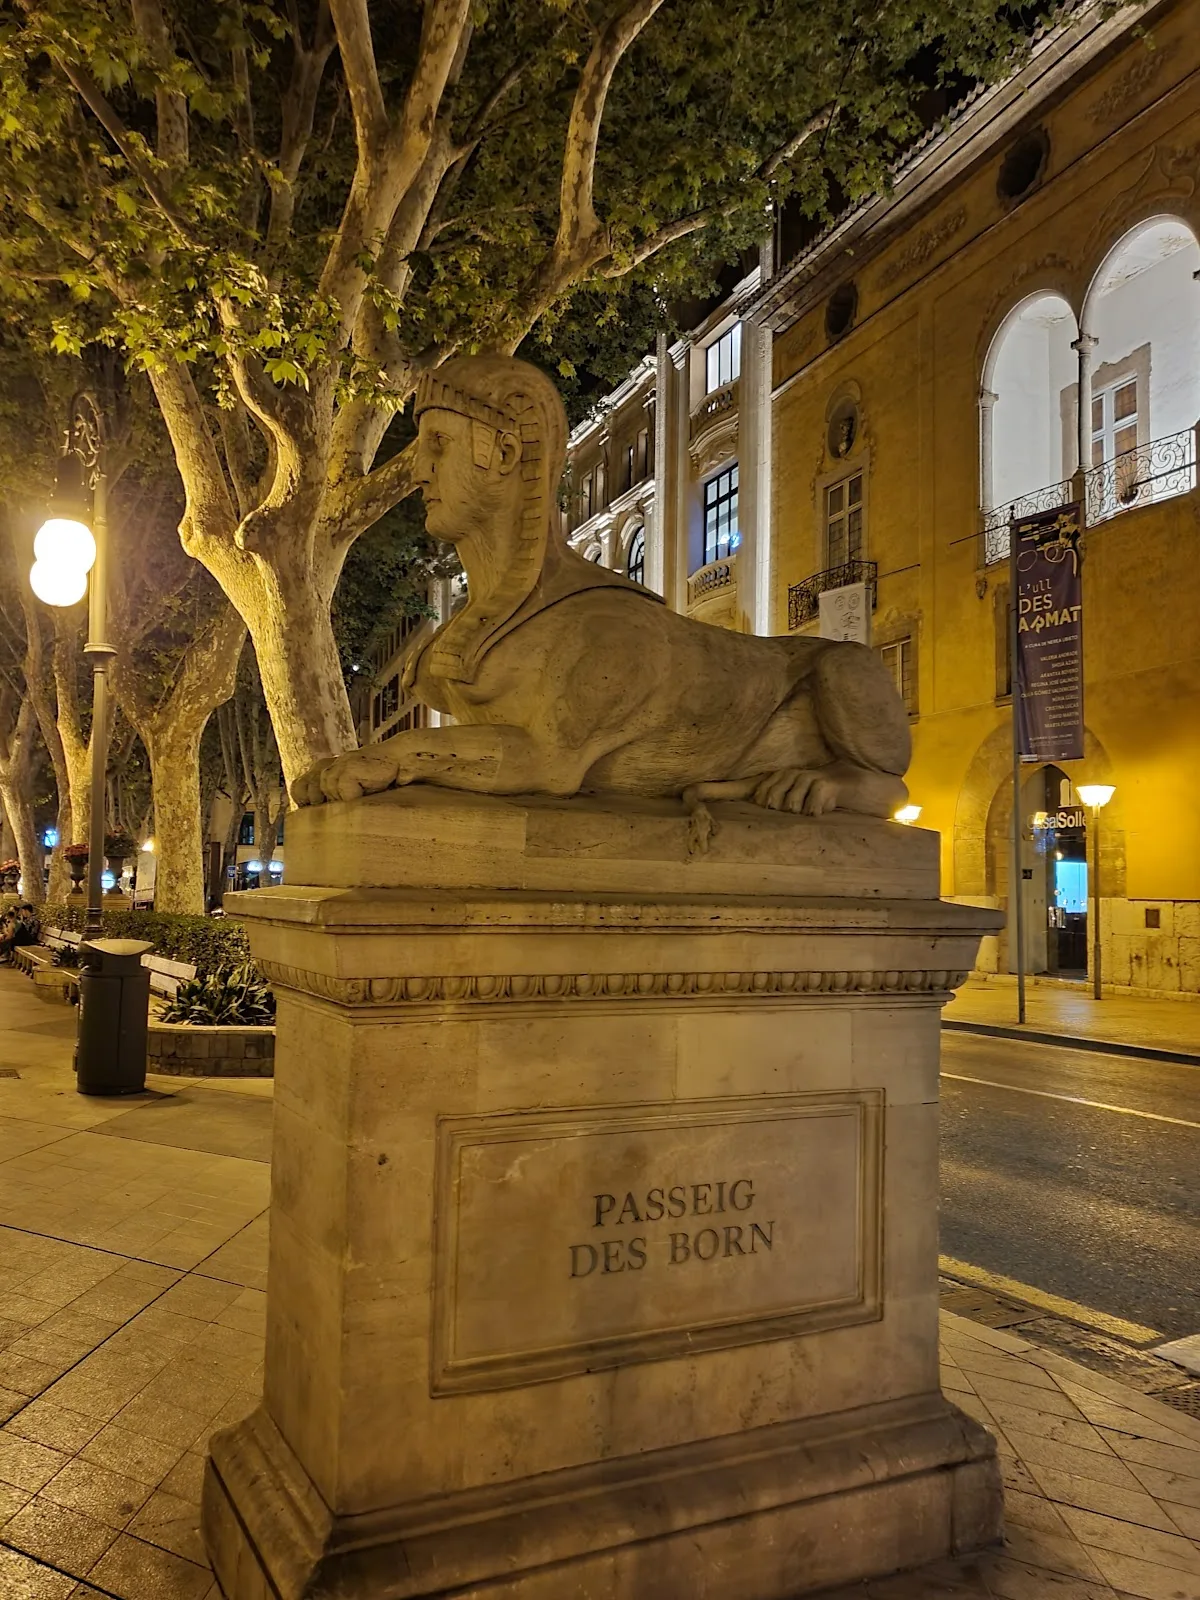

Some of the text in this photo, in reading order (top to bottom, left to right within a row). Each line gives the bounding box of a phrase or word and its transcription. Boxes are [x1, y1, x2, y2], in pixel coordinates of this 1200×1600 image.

[1019, 579, 1052, 596] L'ull
[1019, 594, 1053, 615] DES
[592, 1179, 756, 1228] PASSEIG
[568, 1221, 776, 1280] DES BORN
